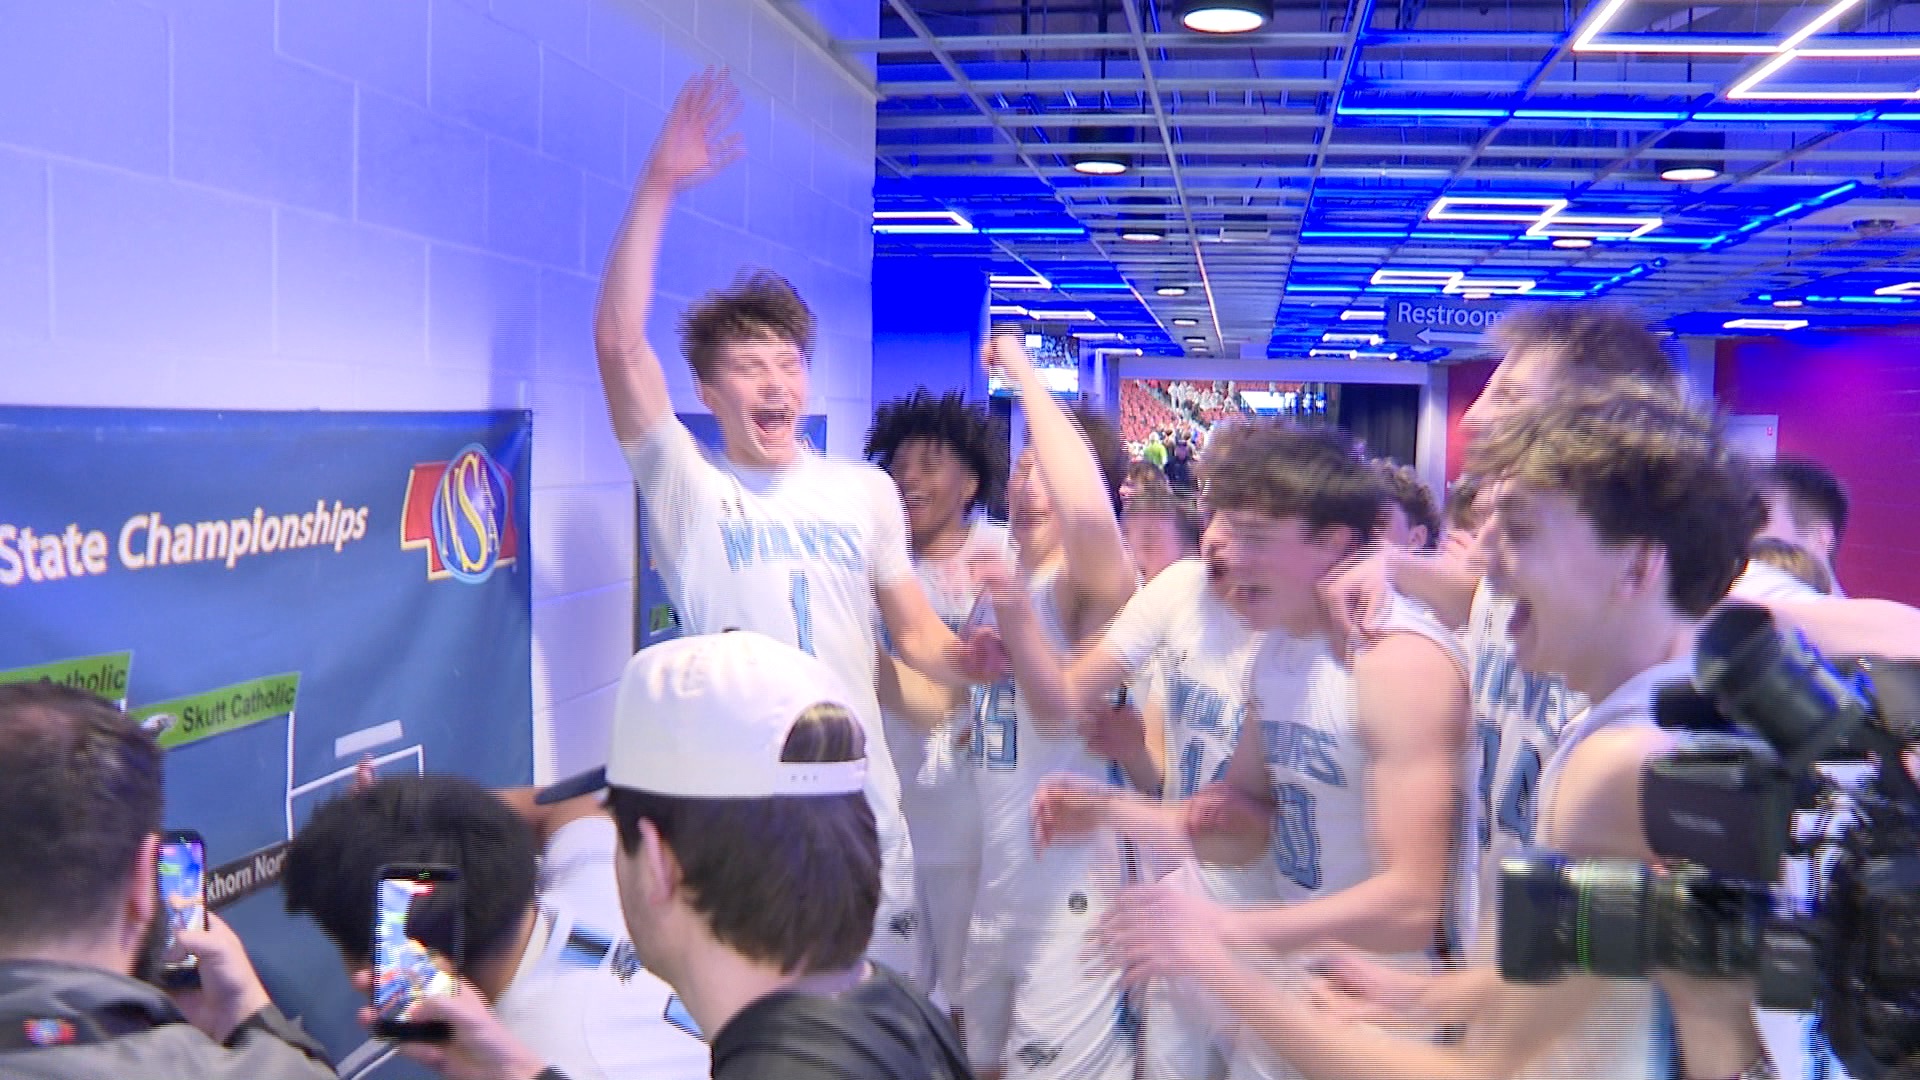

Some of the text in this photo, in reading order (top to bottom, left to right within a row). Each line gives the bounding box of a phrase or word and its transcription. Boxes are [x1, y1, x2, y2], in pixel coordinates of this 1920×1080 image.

[0, 500, 369, 585] State Championships
[718, 520, 864, 571] WOLVES
[788, 570, 816, 657] 1
[40, 663, 126, 690] tholic
[182, 683, 296, 733] Skutt Catholic
